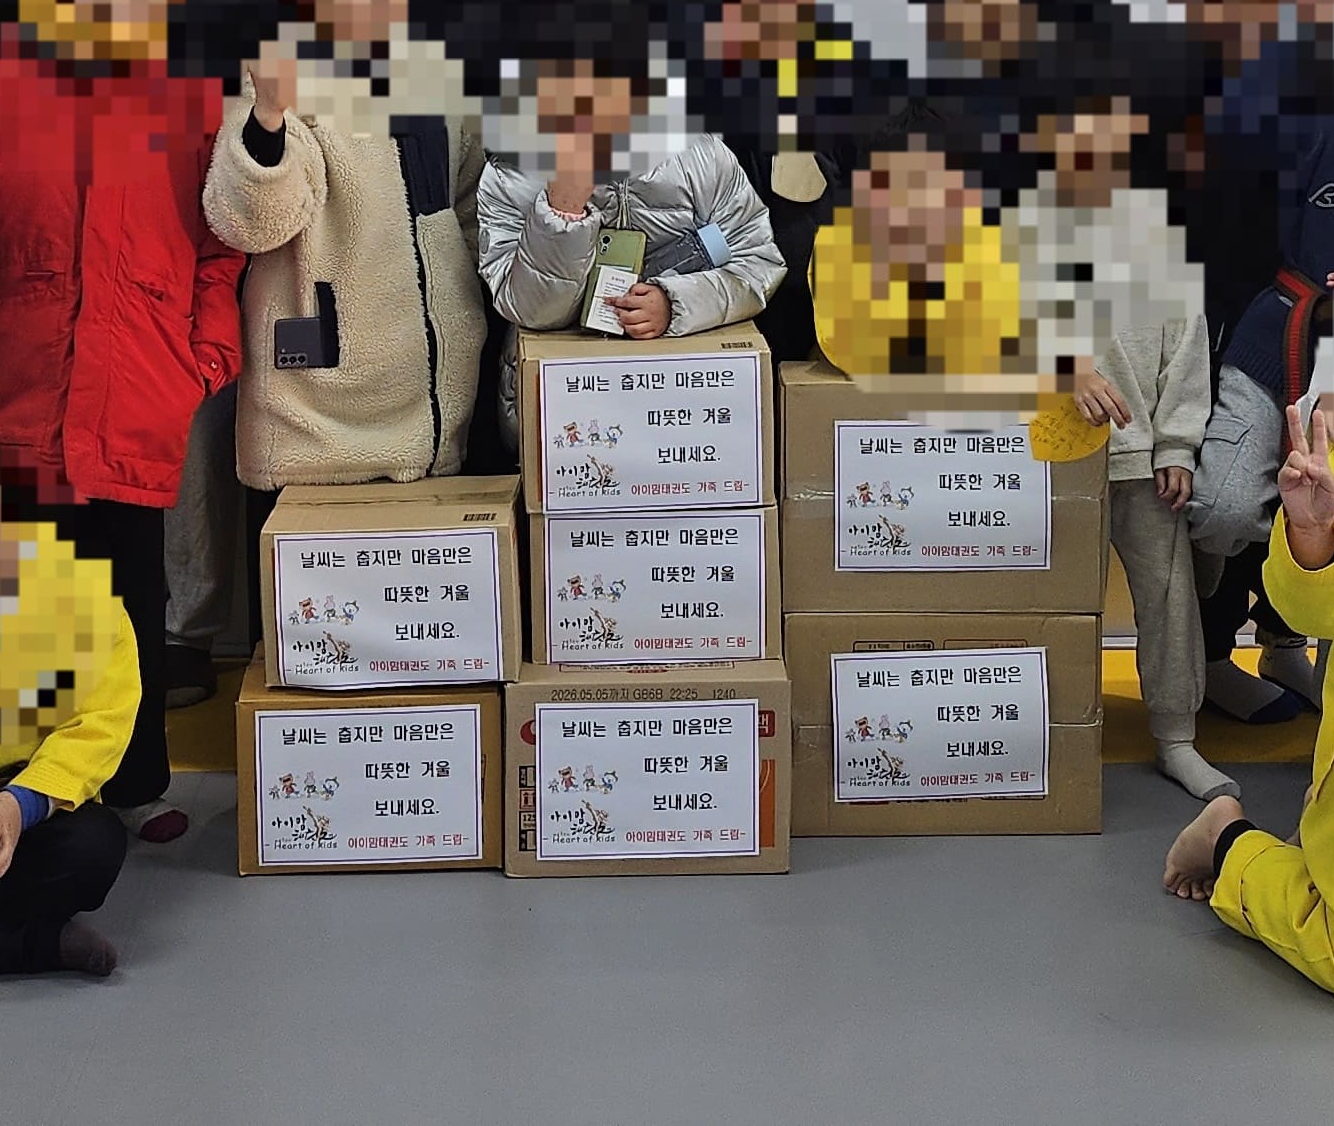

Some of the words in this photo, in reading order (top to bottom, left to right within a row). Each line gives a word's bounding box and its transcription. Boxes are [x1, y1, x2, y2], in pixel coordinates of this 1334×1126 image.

[566, 376, 609, 392] 날씨는
[621, 373, 665, 390] 춥지만
[676, 371, 734, 388] 마음만은
[648, 409, 692, 426] 따뜻한
[703, 408, 731, 424] 겨울
[860, 438, 902, 454] 날씨는
[914, 438, 956, 453] 춥지만
[967, 436, 1024, 453] 마음만은
[658, 446, 720, 463] 보내세요.
[697, 482, 716, 492] 가족
[939, 474, 982, 490] 따뜻한
[993, 474, 1021, 490] 겨울
[558, 487, 586, 498] Heart
[589, 487, 599, 497] of
[948, 511, 1010, 527] 보내세요.
[571, 531, 614, 547] 날씨는
[626, 530, 669, 546] 춥지만
[680, 529, 738, 545] 마음만은
[301, 552, 345, 568] 날씨는
[357, 550, 401, 566] 춥지만
[412, 547, 471, 565] 마음만은
[850, 548, 877, 557] Heart
[879, 548, 890, 556] of
[987, 546, 1005, 556] 가족
[652, 566, 695, 582] 따뜻한
[707, 566, 734, 582] 겨울
[385, 586, 429, 603] 따뜻한
[440, 585, 469, 601] 겨울
[661, 602, 723, 618] 보내세요.
[395, 622, 459, 640] 보내세요.
[561, 641, 590, 651] Heart
[591, 641, 603, 650] of
[700, 638, 719, 648] 가족
[295, 665, 324, 675] Heart
[326, 665, 337, 674] of
[437, 660, 456, 671] 가족
[857, 671, 899, 687] 날씨는
[911, 669, 953, 686] 춥지만
[964, 666, 1021, 684] 마음만은
[938, 706, 980, 722] 따뜻한
[991, 704, 1019, 721] 겨울
[283, 728, 326, 745] 날씨는
[339, 726, 383, 743] 춥지만
[394, 723, 454, 741] 마음만은
[562, 721, 606, 737] 날씨는
[618, 720, 662, 736] 춥지만
[673, 718, 732, 735] 마음만은
[947, 741, 1008, 757] 보내세요.
[366, 762, 410, 779] 따뜻한
[421, 761, 450, 777] 겨울
[645, 756, 689, 774] 따뜻한
[700, 755, 728, 772] 겨울
[849, 779, 877, 787] Heart
[879, 778, 890, 787] of
[985, 773, 1003, 783] 가족
[375, 799, 439, 816] 보내세요.
[653, 793, 717, 810] 보내세요.
[416, 835, 435, 846] 가족
[552, 834, 581, 845] Heart
[583, 834, 594, 843] of
[693, 830, 712, 841] 가족
[274, 840, 302, 851] Heart
[304, 840, 317, 850] of
